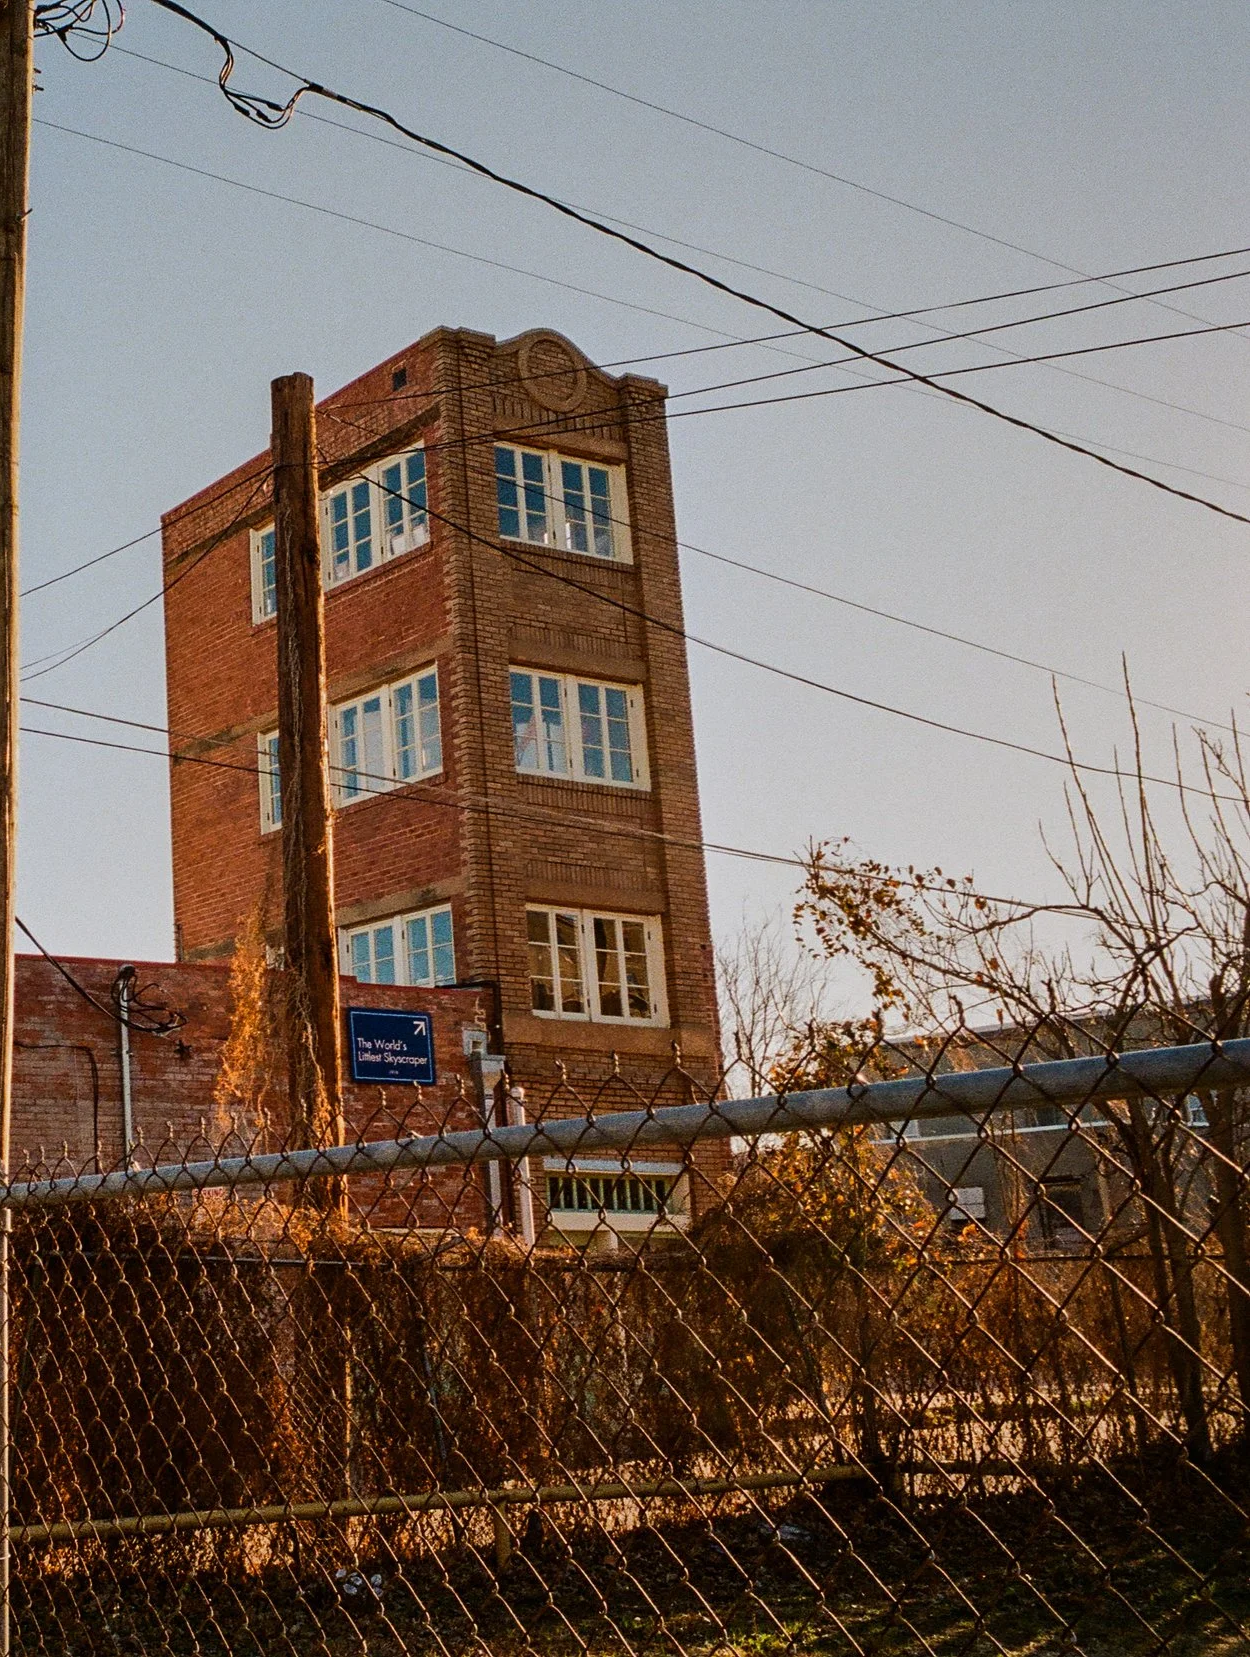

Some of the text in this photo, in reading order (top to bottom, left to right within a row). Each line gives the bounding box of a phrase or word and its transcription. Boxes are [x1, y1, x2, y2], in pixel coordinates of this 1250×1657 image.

[356, 1037, 408, 1051] The World's
[358, 1051, 428, 1068] Littlest Skyscraper
